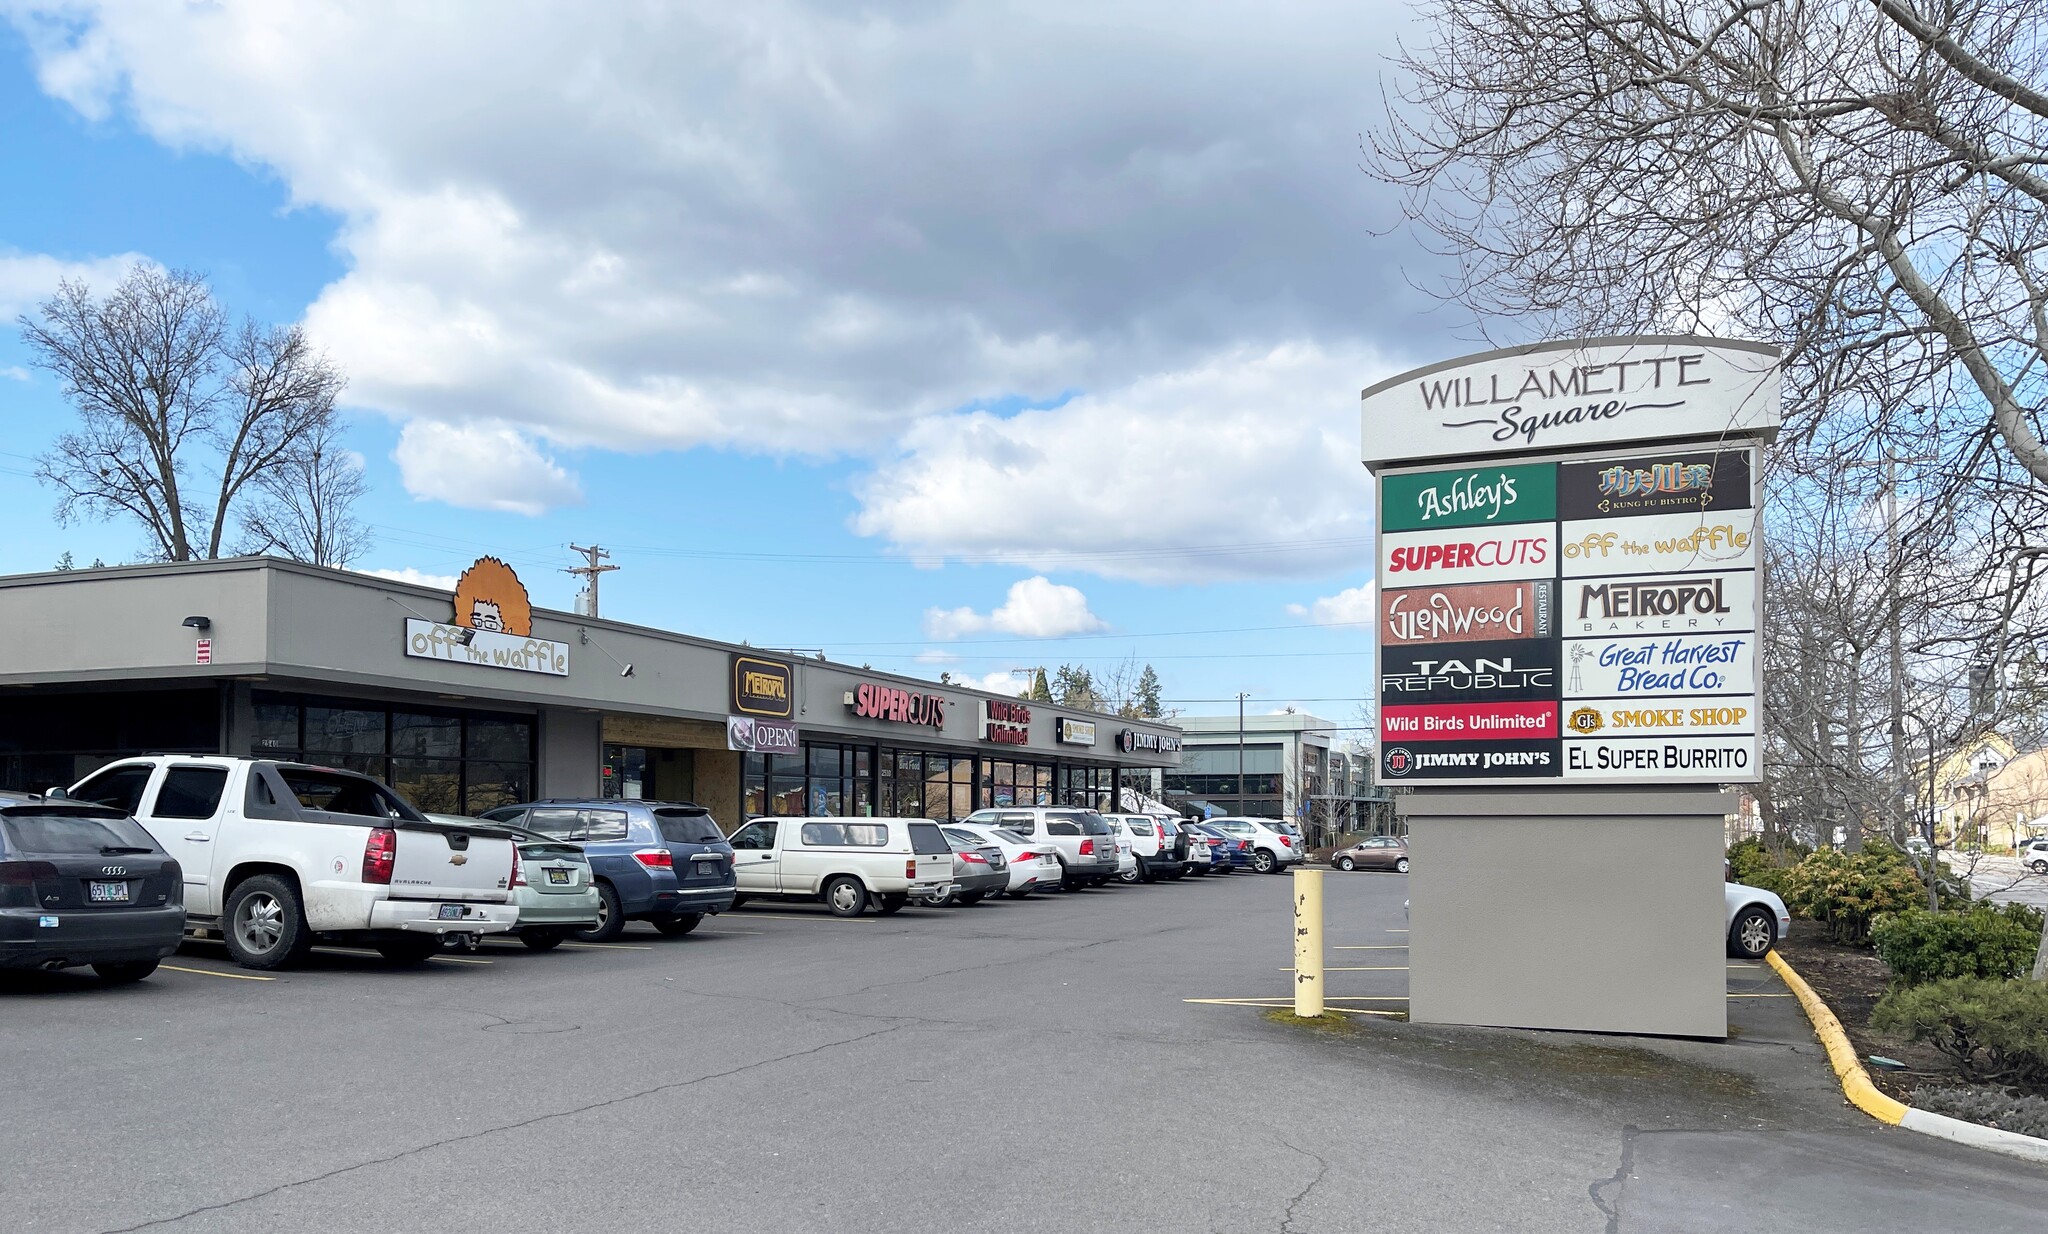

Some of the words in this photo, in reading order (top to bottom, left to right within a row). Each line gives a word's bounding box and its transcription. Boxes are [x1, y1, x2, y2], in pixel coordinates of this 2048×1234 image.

[1419, 353, 1711, 411] WILLAMETTE
[1492, 400, 1627, 444] Square
[1418, 473, 1518, 521] Ashley's
[1613, 501, 1641, 509] KUNG
[1660, 497, 1697, 506] BISTRO
[1563, 532, 1619, 559] off
[1621, 541, 1650, 556] the
[1654, 524, 1751, 554] waffle
[1388, 537, 1548, 573] SUPERCUTS
[1538, 584, 1549, 635] RESTAURANT
[1577, 577, 1731, 620] METROPOL
[411, 624, 464, 660] off
[464, 643, 490, 664] the
[493, 639, 566, 673] waffle
[1599, 643, 1659, 667] Great
[1662, 638, 1746, 665] Harvest
[1412, 657, 1513, 676] TAN
[742, 670, 787, 702] METROPOL
[1382, 672, 1553, 693] REPUBLIC
[1617, 667, 1687, 692] Bread
[856, 682, 946, 728] SUPERCUTS
[991, 700, 1008, 720] Wild
[1010, 703, 1031, 724] Birds
[1385, 717, 1419, 731] Wild
[1424, 716, 1465, 731] Birds
[1611, 709, 1684, 728] SMOKE
[1689, 707, 1747, 726] SHOP
[756, 726, 796, 747] OPEN!
[990, 724, 1028, 745] Unlimited
[1133, 732, 1157, 751] JIMMY
[1158, 735, 1180, 753] JOHN'S
[909, 760, 920, 770] Food
[1415, 753, 1479, 769] JIMMY
[1484, 752, 1550, 768] JOHN'S
[91, 884, 106, 896] 651
[113, 884, 128, 896] JPL
